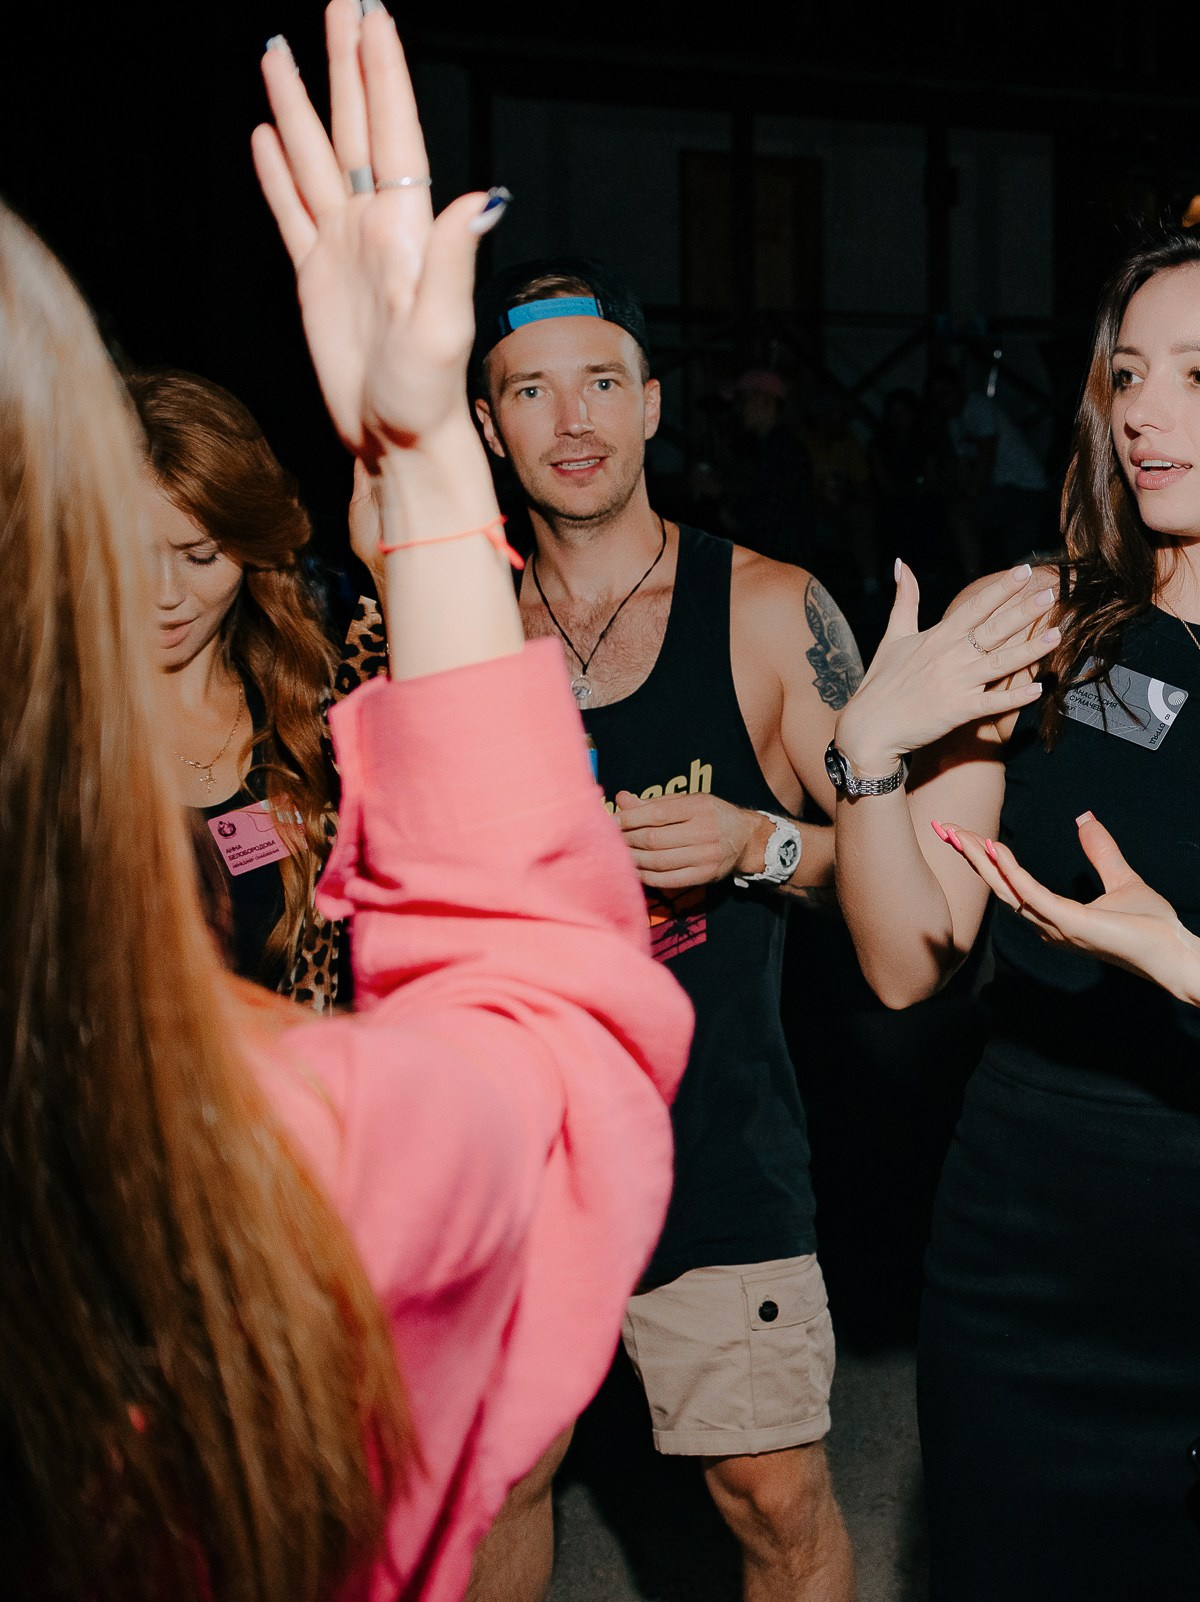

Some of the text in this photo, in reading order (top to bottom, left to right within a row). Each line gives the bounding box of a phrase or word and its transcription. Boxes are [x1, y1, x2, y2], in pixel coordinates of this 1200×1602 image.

[1069, 694, 1104, 713] СУМАЧЕВ
[1073, 689, 1118, 709] АНАСТСИЯ
[1148, 722, 1166, 745] ОТРЯД
[226, 844, 242, 854] АННА
[228, 839, 276, 861] БЕЛОБОРОДОВА
